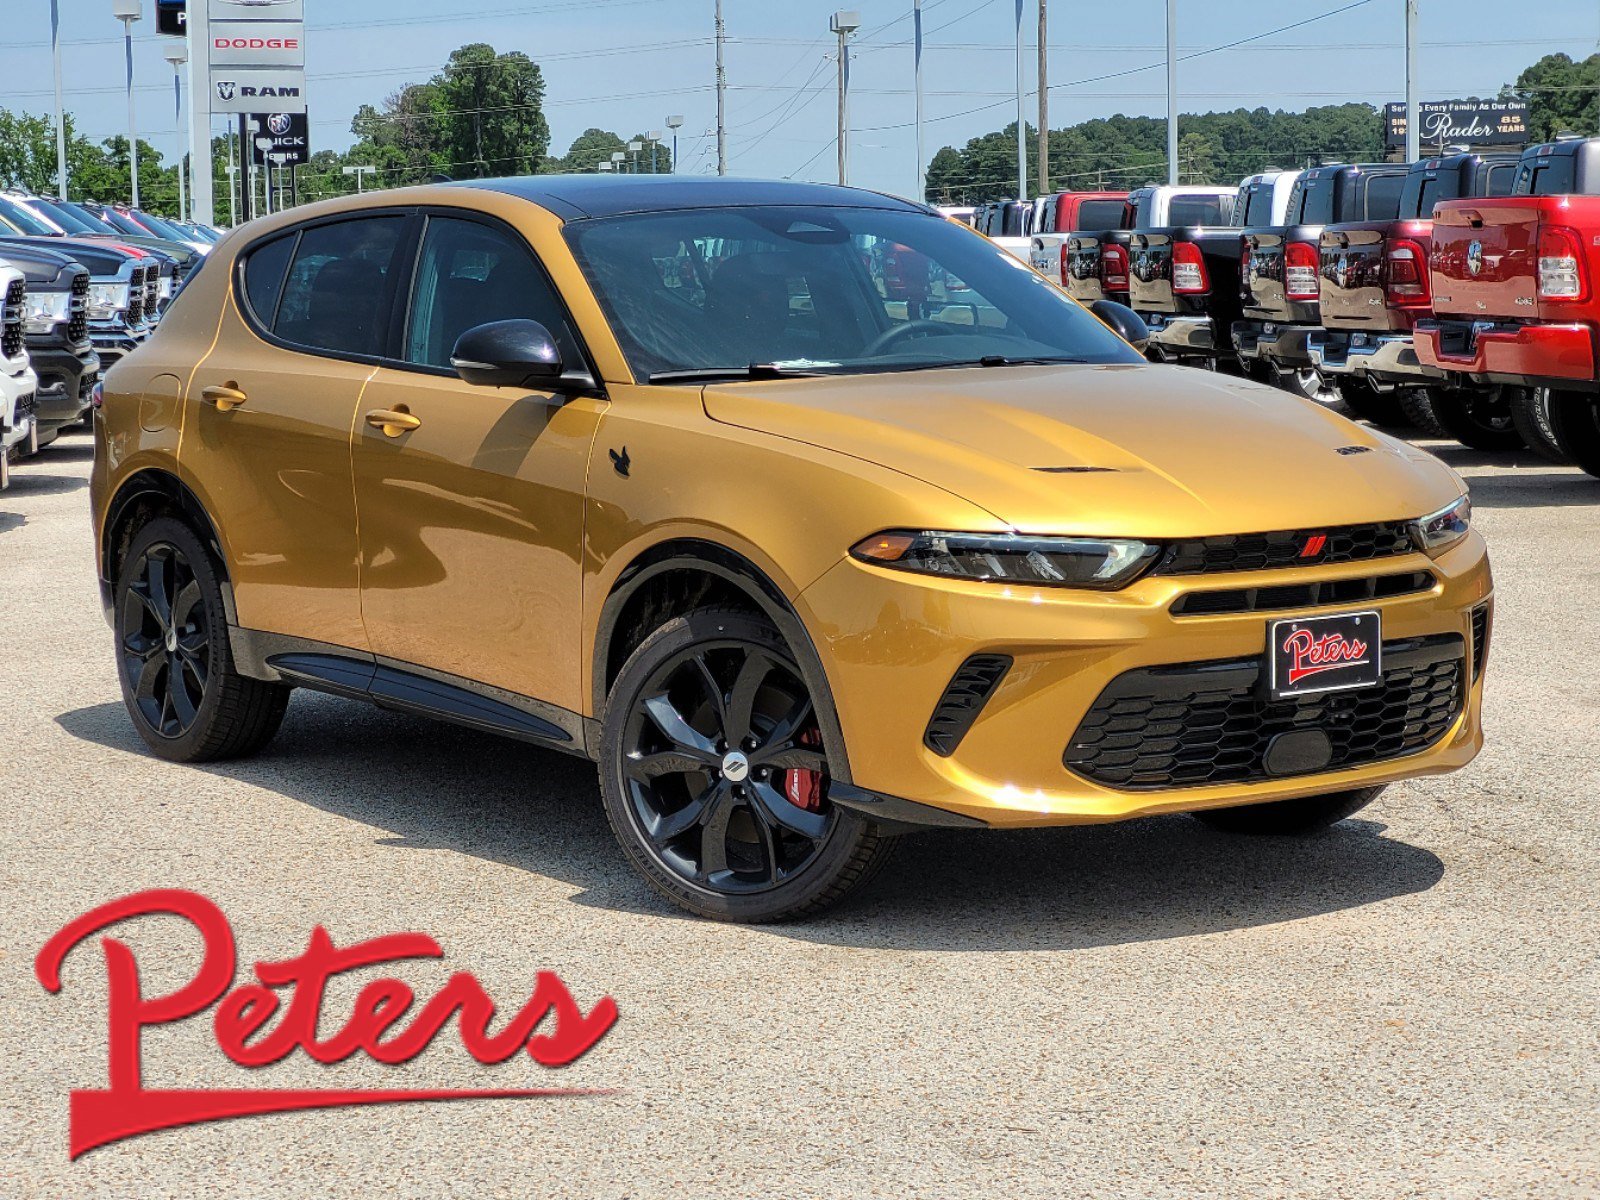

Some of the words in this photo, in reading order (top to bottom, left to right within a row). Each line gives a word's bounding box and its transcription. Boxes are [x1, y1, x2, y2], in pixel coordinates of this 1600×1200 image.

[214, 38, 299, 49] DODGE
[240, 86, 300, 97] RAM
[1424, 103, 1447, 113] Every
[1448, 103, 1477, 112] Family
[1479, 102, 1490, 111] As
[1491, 102, 1506, 111] Our
[1507, 101, 1526, 110] Own
[1419, 112, 1494, 139] Rader
[1496, 124, 1526, 133] YEARS
[1283, 629, 1368, 684] Peters
